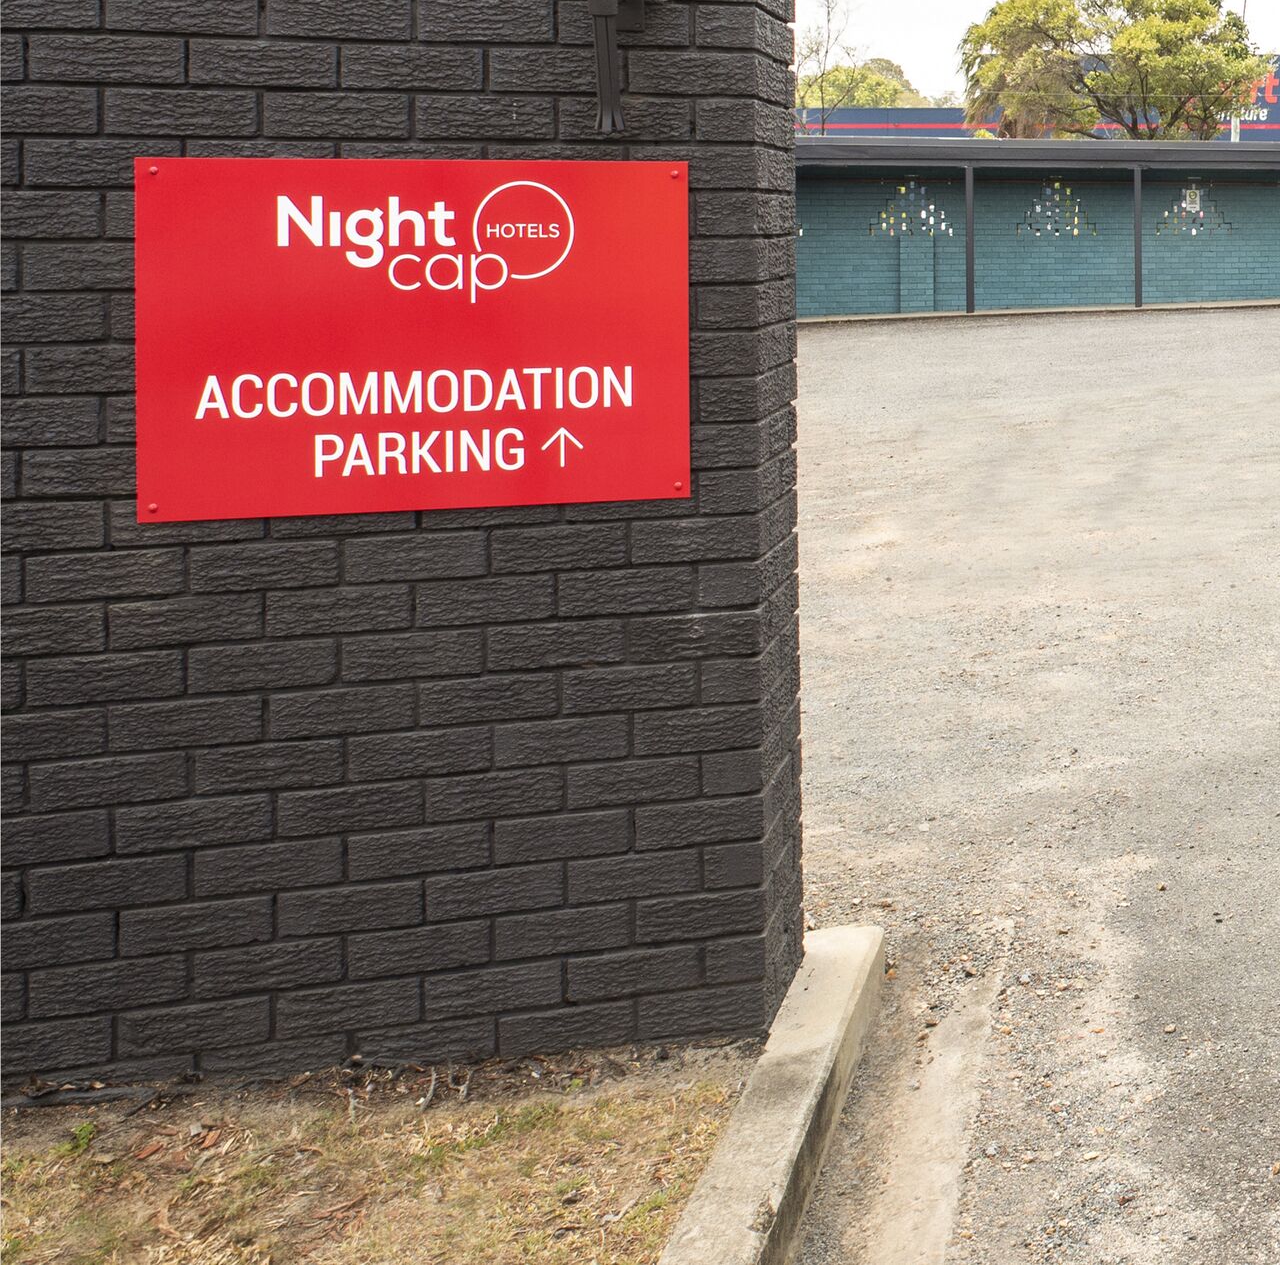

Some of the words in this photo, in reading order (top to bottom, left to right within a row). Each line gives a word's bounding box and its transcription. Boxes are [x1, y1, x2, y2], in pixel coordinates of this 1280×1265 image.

[276, 195, 456, 268] Night
[486, 223, 560, 239] HOTELS
[388, 253, 509, 303] cap
[195, 365, 633, 420] ACCOMMODATION
[314, 427, 525, 478] PARKING
